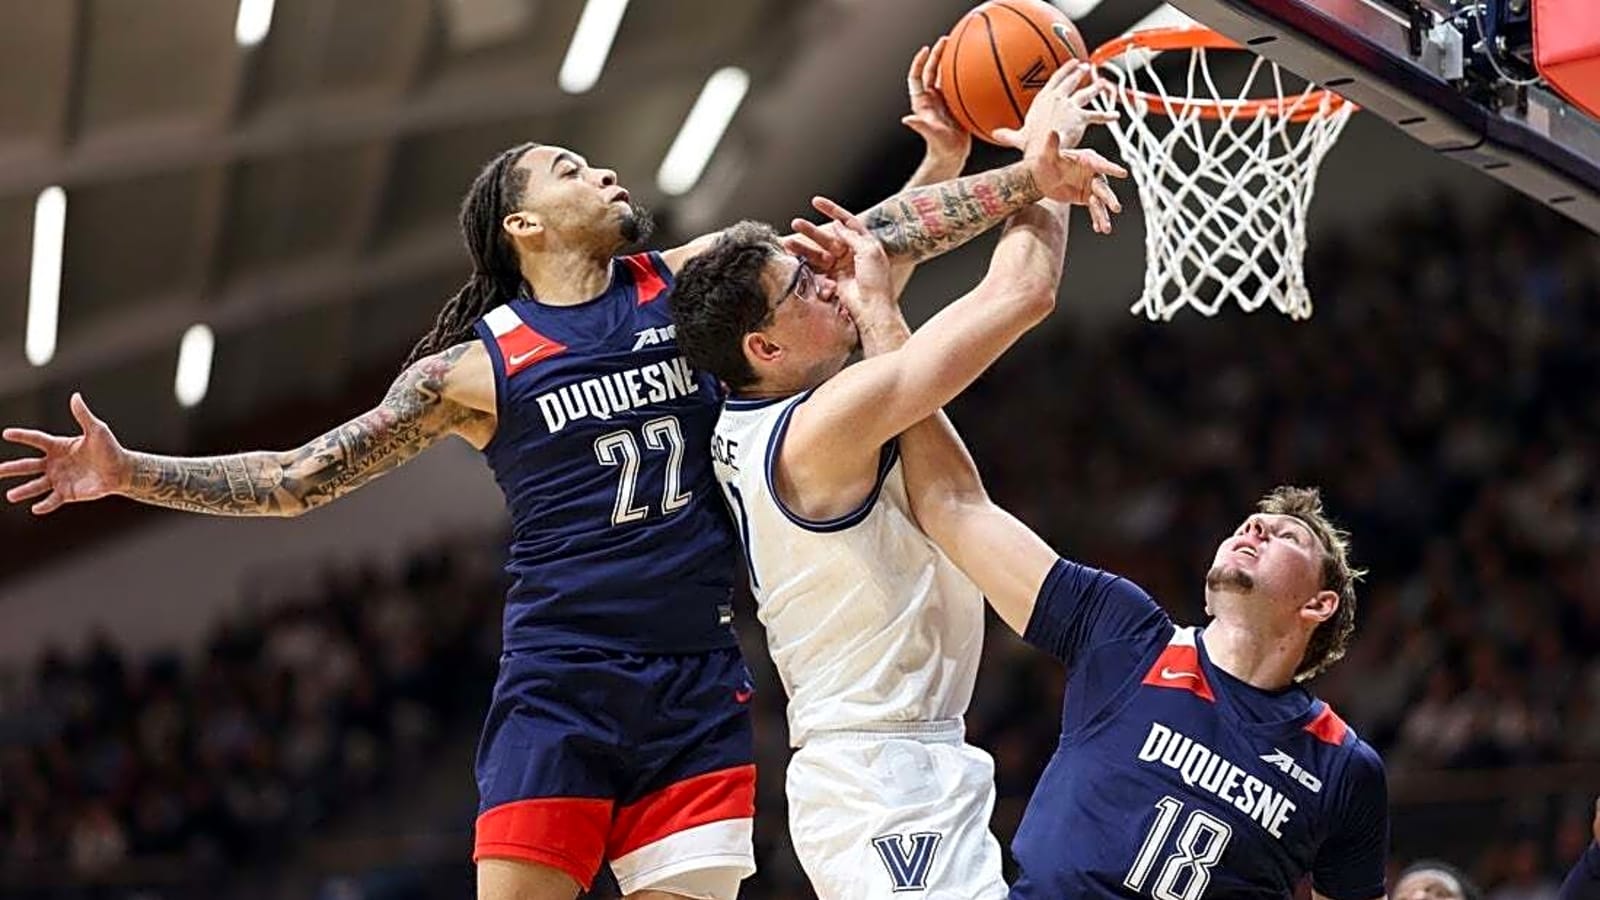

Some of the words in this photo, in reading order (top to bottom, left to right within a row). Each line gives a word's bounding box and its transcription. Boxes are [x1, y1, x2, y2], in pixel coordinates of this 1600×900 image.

[536, 356, 699, 434] DUQUESNE
[593, 415, 694, 527] 22
[1138, 722, 1297, 839] DUQUESNE
[1260, 748, 1322, 793] A10
[872, 832, 943, 893] V
[1123, 795, 1232, 900] 18
